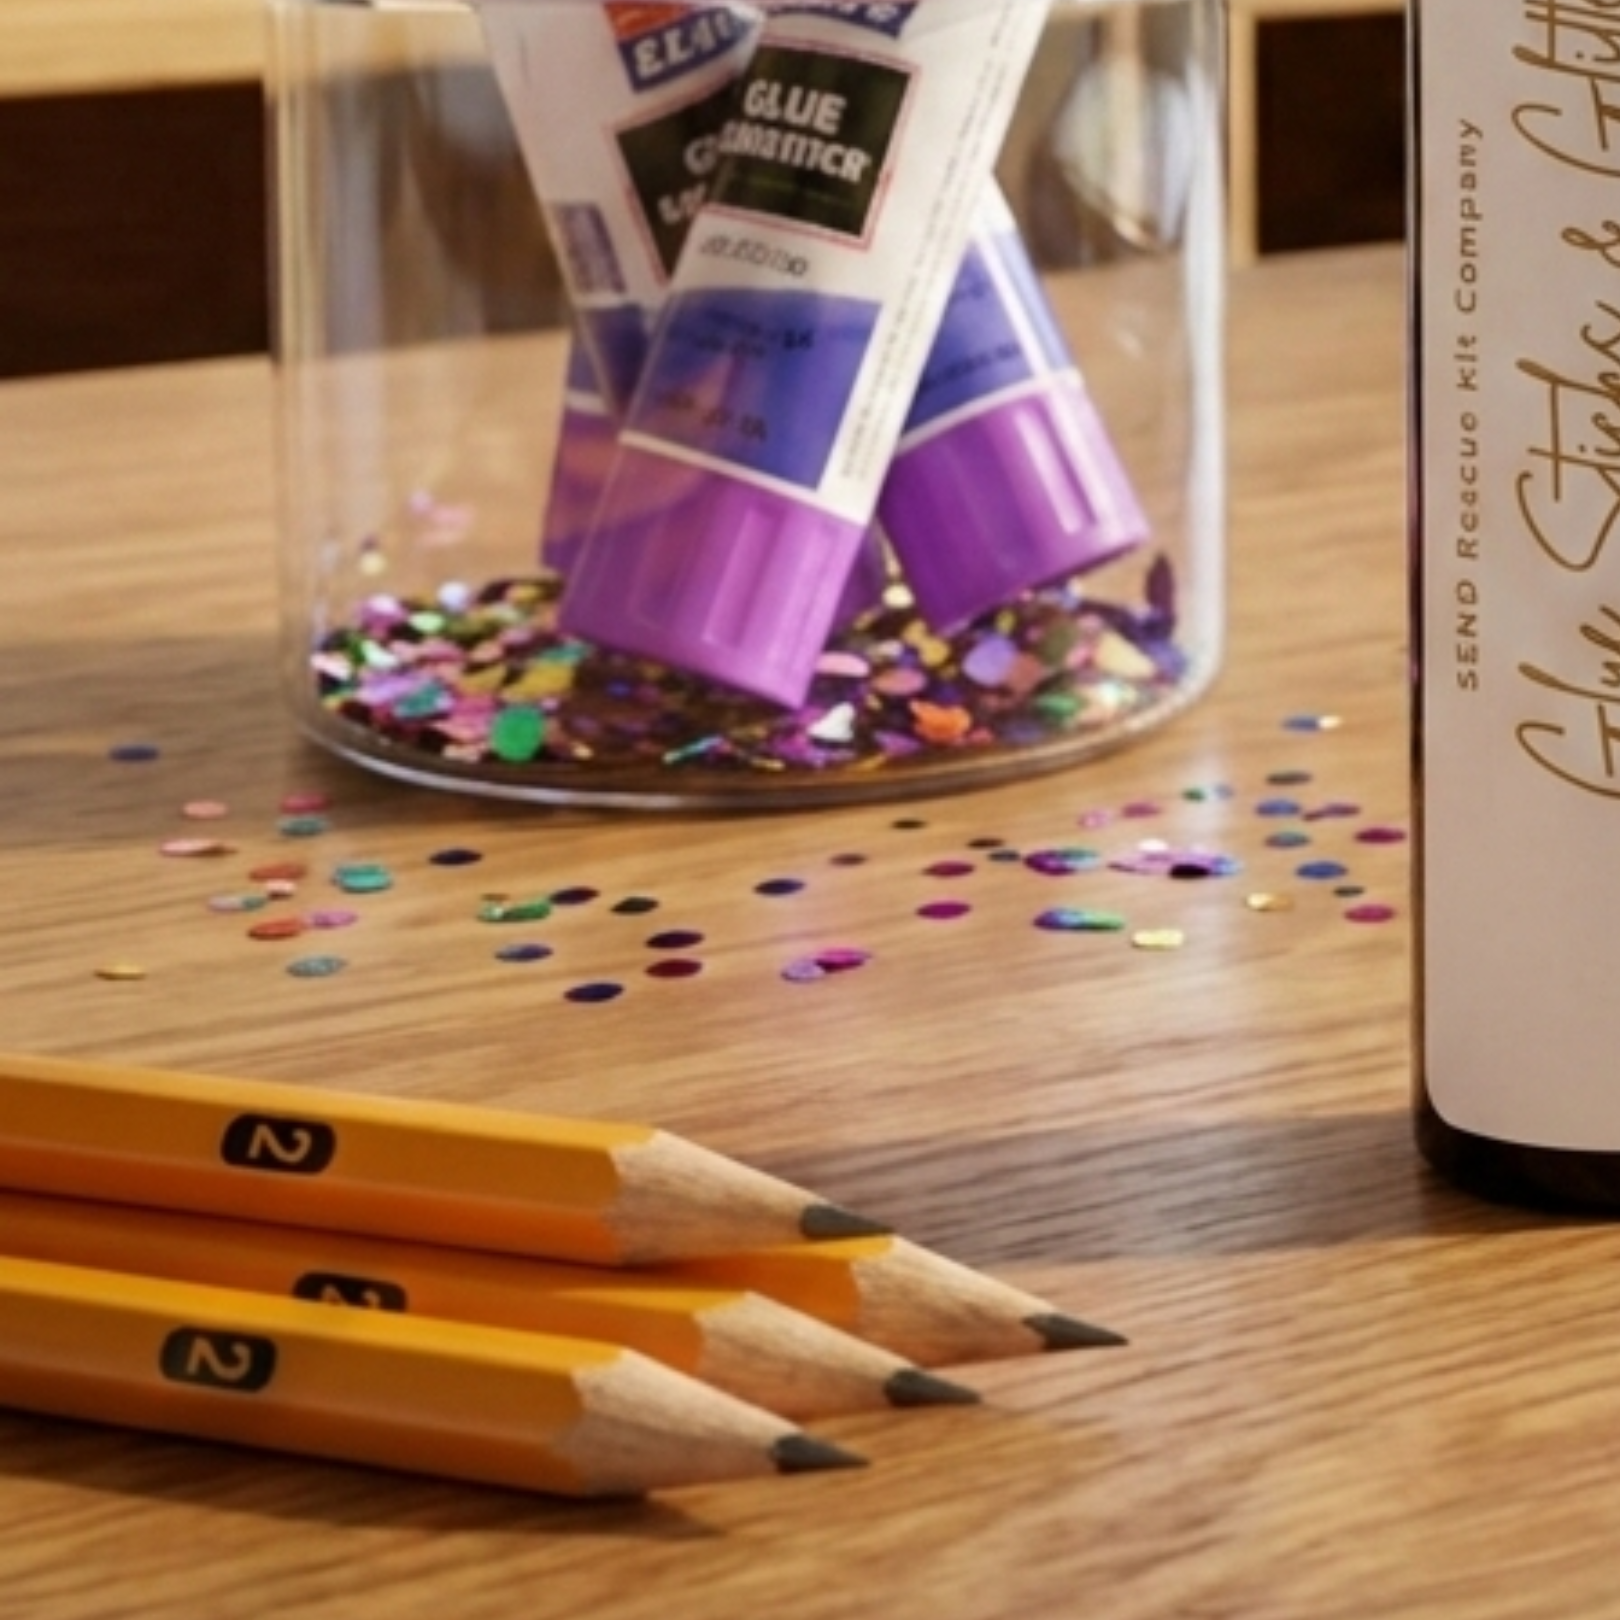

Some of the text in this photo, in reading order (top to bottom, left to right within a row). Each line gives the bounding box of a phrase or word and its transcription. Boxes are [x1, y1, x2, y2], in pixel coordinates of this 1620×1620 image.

[744, 79, 847, 135] GLUE
[1454, 118, 1484, 315] Company
[1455, 578, 1480, 692] SEND
[247, 1124, 312, 1164] 2
[187, 1337, 252, 1381] 2
